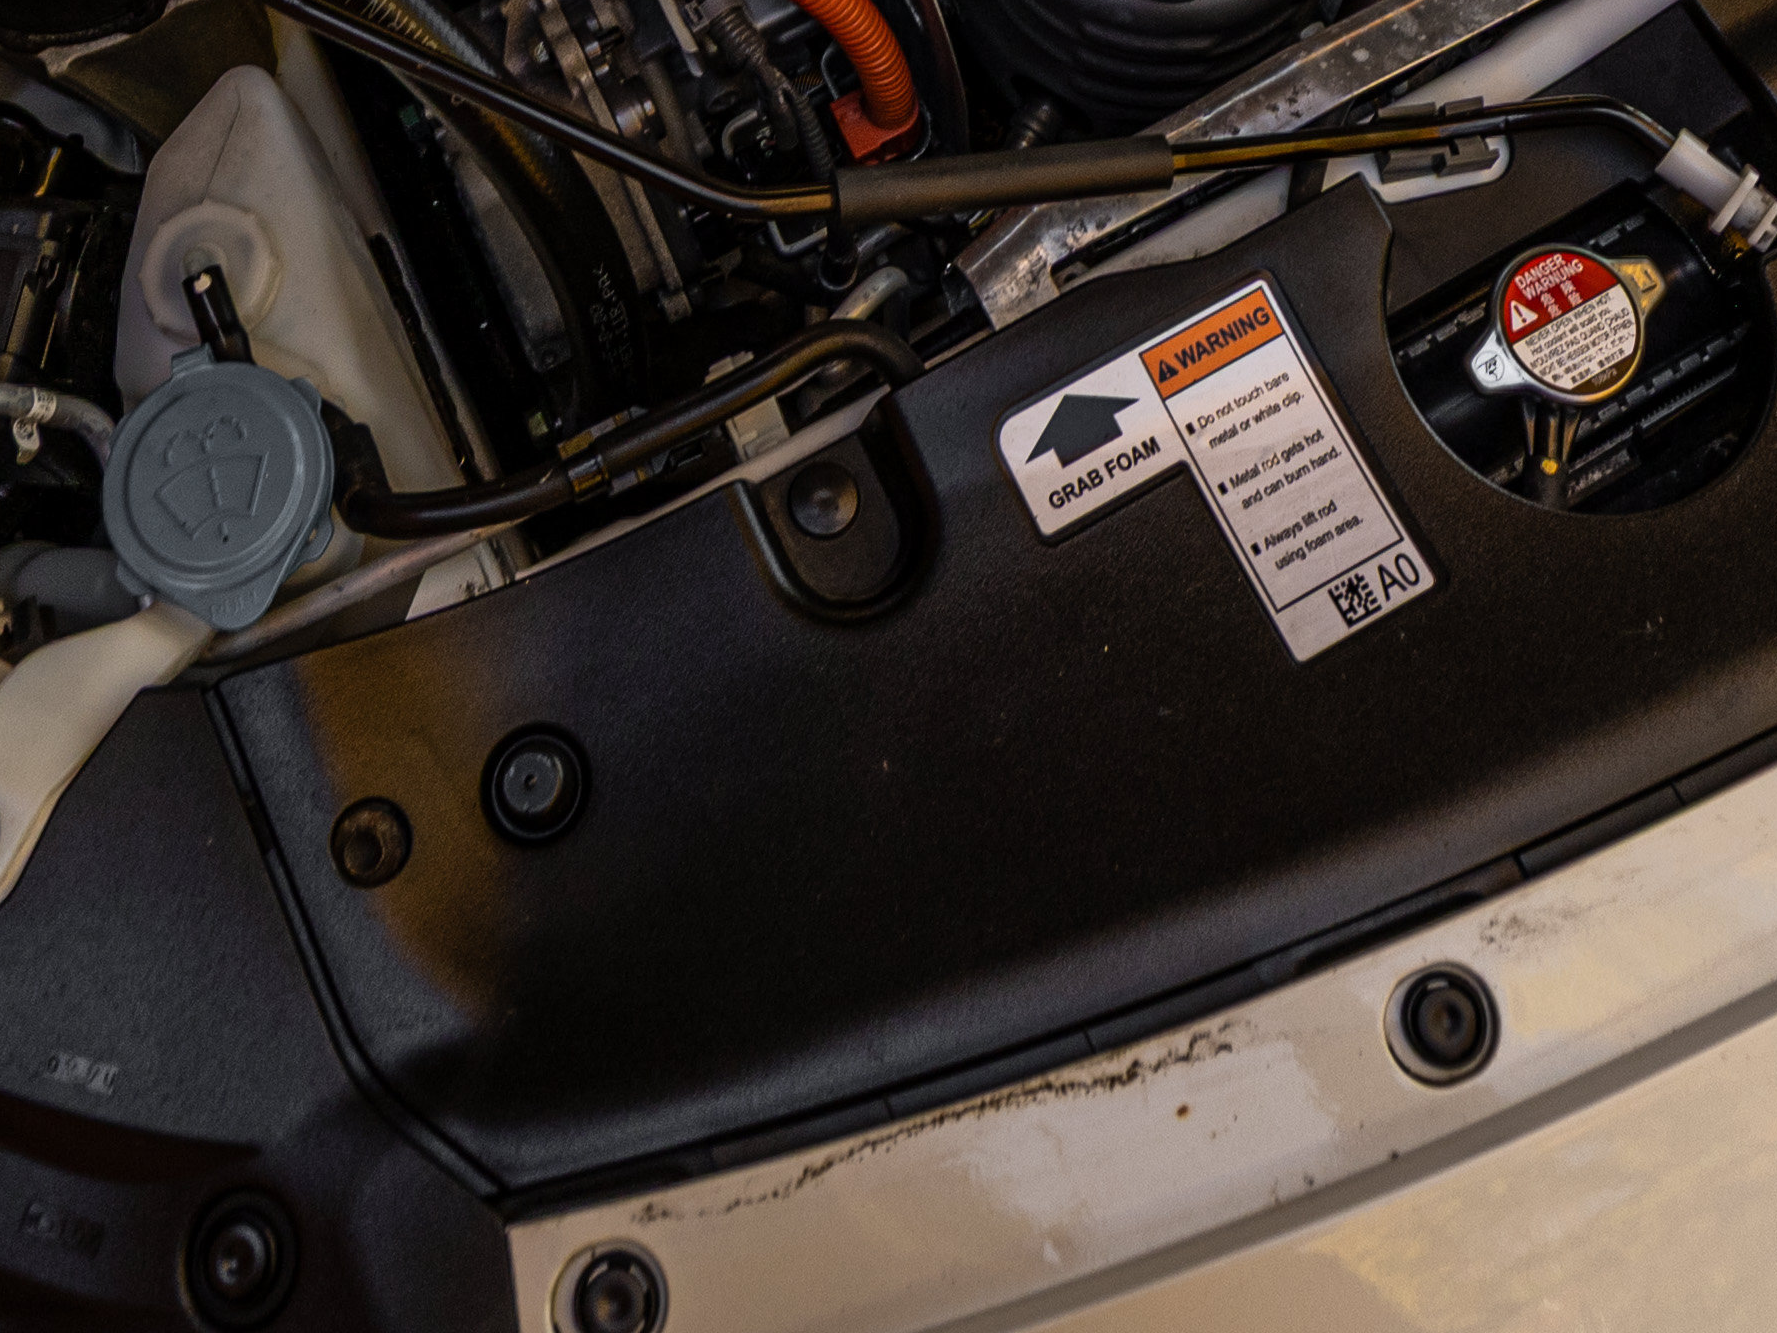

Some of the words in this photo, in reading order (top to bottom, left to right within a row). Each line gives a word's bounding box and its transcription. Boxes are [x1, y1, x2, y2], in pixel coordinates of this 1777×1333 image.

[1515, 253, 1566, 289] DANGER
[1523, 259, 1583, 300] WARNUNG
[1174, 306, 1271, 370] WARNING
[1196, 413, 1215, 430] Do
[1216, 402, 1234, 420] not
[1234, 385, 1265, 410] touch
[1264, 371, 1290, 392] bare
[1208, 423, 1239, 449] metal
[1239, 416, 1251, 431] or
[1252, 404, 1282, 425] white
[1282, 391, 1304, 410] clip.
[1048, 468, 1105, 509] GRAB
[1104, 436, 1161, 477] FOAM
[1229, 464, 1261, 489] Metal
[1261, 453, 1280, 472] rod
[1281, 440, 1306, 463] gets
[1304, 429, 1325, 447] hot
[1241, 489, 1263, 510] and
[1263, 479, 1285, 497] can
[1284, 462, 1310, 484] burn
[1309, 445, 1342, 471] hand.
[1263, 522, 1303, 551] Always
[1301, 510, 1318, 529] lift
[1318, 499, 1337, 518] rod
[1275, 545, 1307, 571] using
[1304, 530, 1334, 553] foam
[1335, 514, 1363, 536] area.
[1377, 553, 1421, 601] A0
